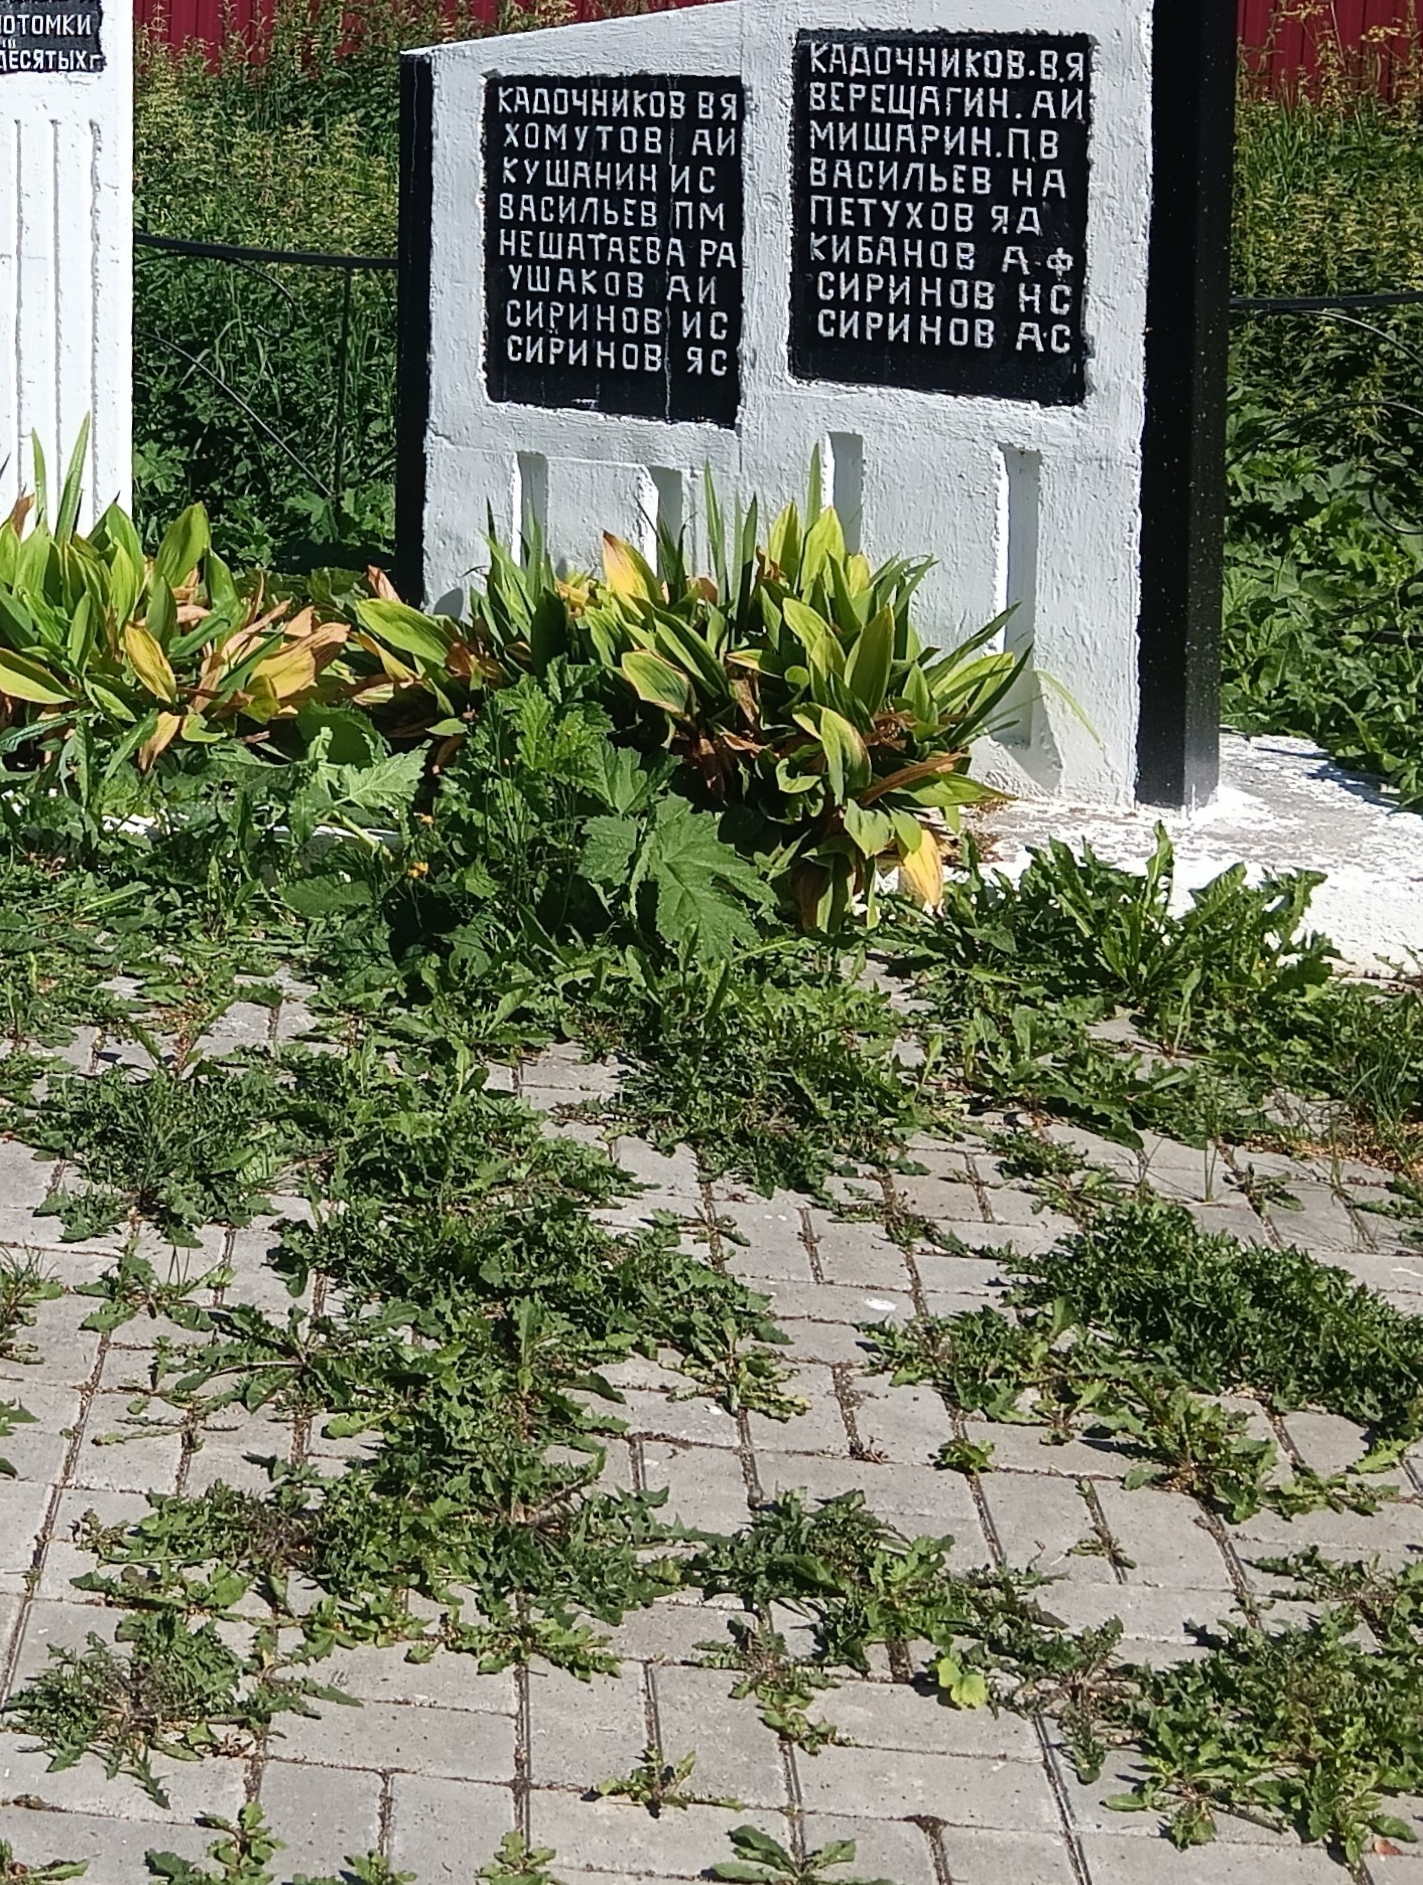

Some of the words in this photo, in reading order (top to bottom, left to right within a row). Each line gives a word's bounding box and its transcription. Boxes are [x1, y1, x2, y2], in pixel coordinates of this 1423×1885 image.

[497, 85, 686, 120] КАДОЧНИКОВ
[697, 91, 738, 121] ВЯ
[503, 122, 663, 155] ХОМУТОВ
[691, 127, 736, 156] АИ
[502, 156, 657, 193] КУШАНИН
[808, 156, 992, 195] ВАСИЛЬЕВ
[498, 193, 658, 228] ВАСИЛЬЕВ
[675, 201, 725, 231] ПМ
[809, 195, 975, 233] ПЕТУХОВ
[499, 229, 686, 268] НЕШАТАЕВА
[699, 238, 737, 269] РА
[809, 232, 976, 271] КИБАНОВ
[508, 264, 644, 298] УШАКОВ
[816, 270, 995, 311] СИРИНОВ
[506, 299, 663, 335] СИРИНОВ
[816, 308, 995, 349] СИРИНОВ
[506, 335, 662, 373] СИРИНОВ
